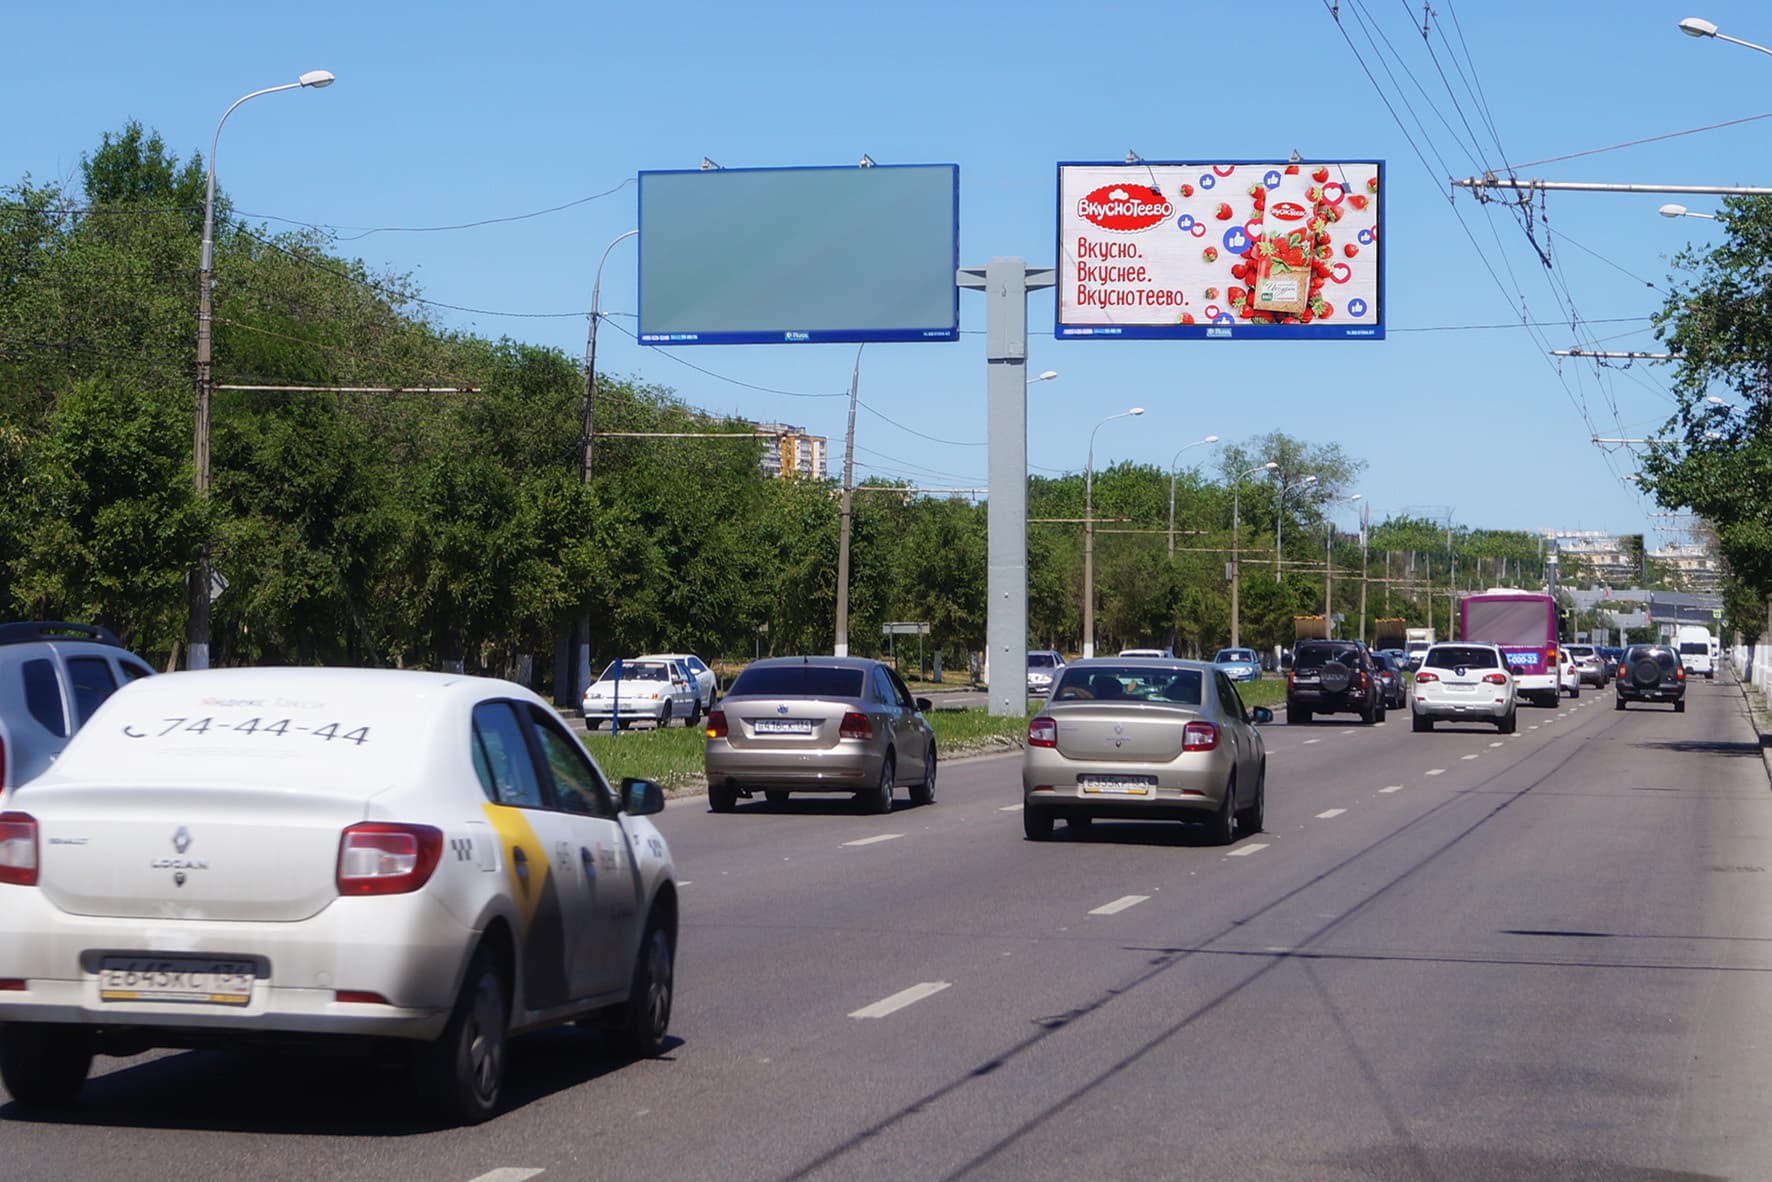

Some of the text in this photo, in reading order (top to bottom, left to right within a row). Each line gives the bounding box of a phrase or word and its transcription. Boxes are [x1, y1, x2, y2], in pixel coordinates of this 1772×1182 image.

[1077, 236, 1143, 262] Вкусно.
[1077, 260, 1152, 286] Вкуснее.
[1077, 283, 1190, 309] Вкуснотеево.
[157, 717, 371, 746] 74-44-44
